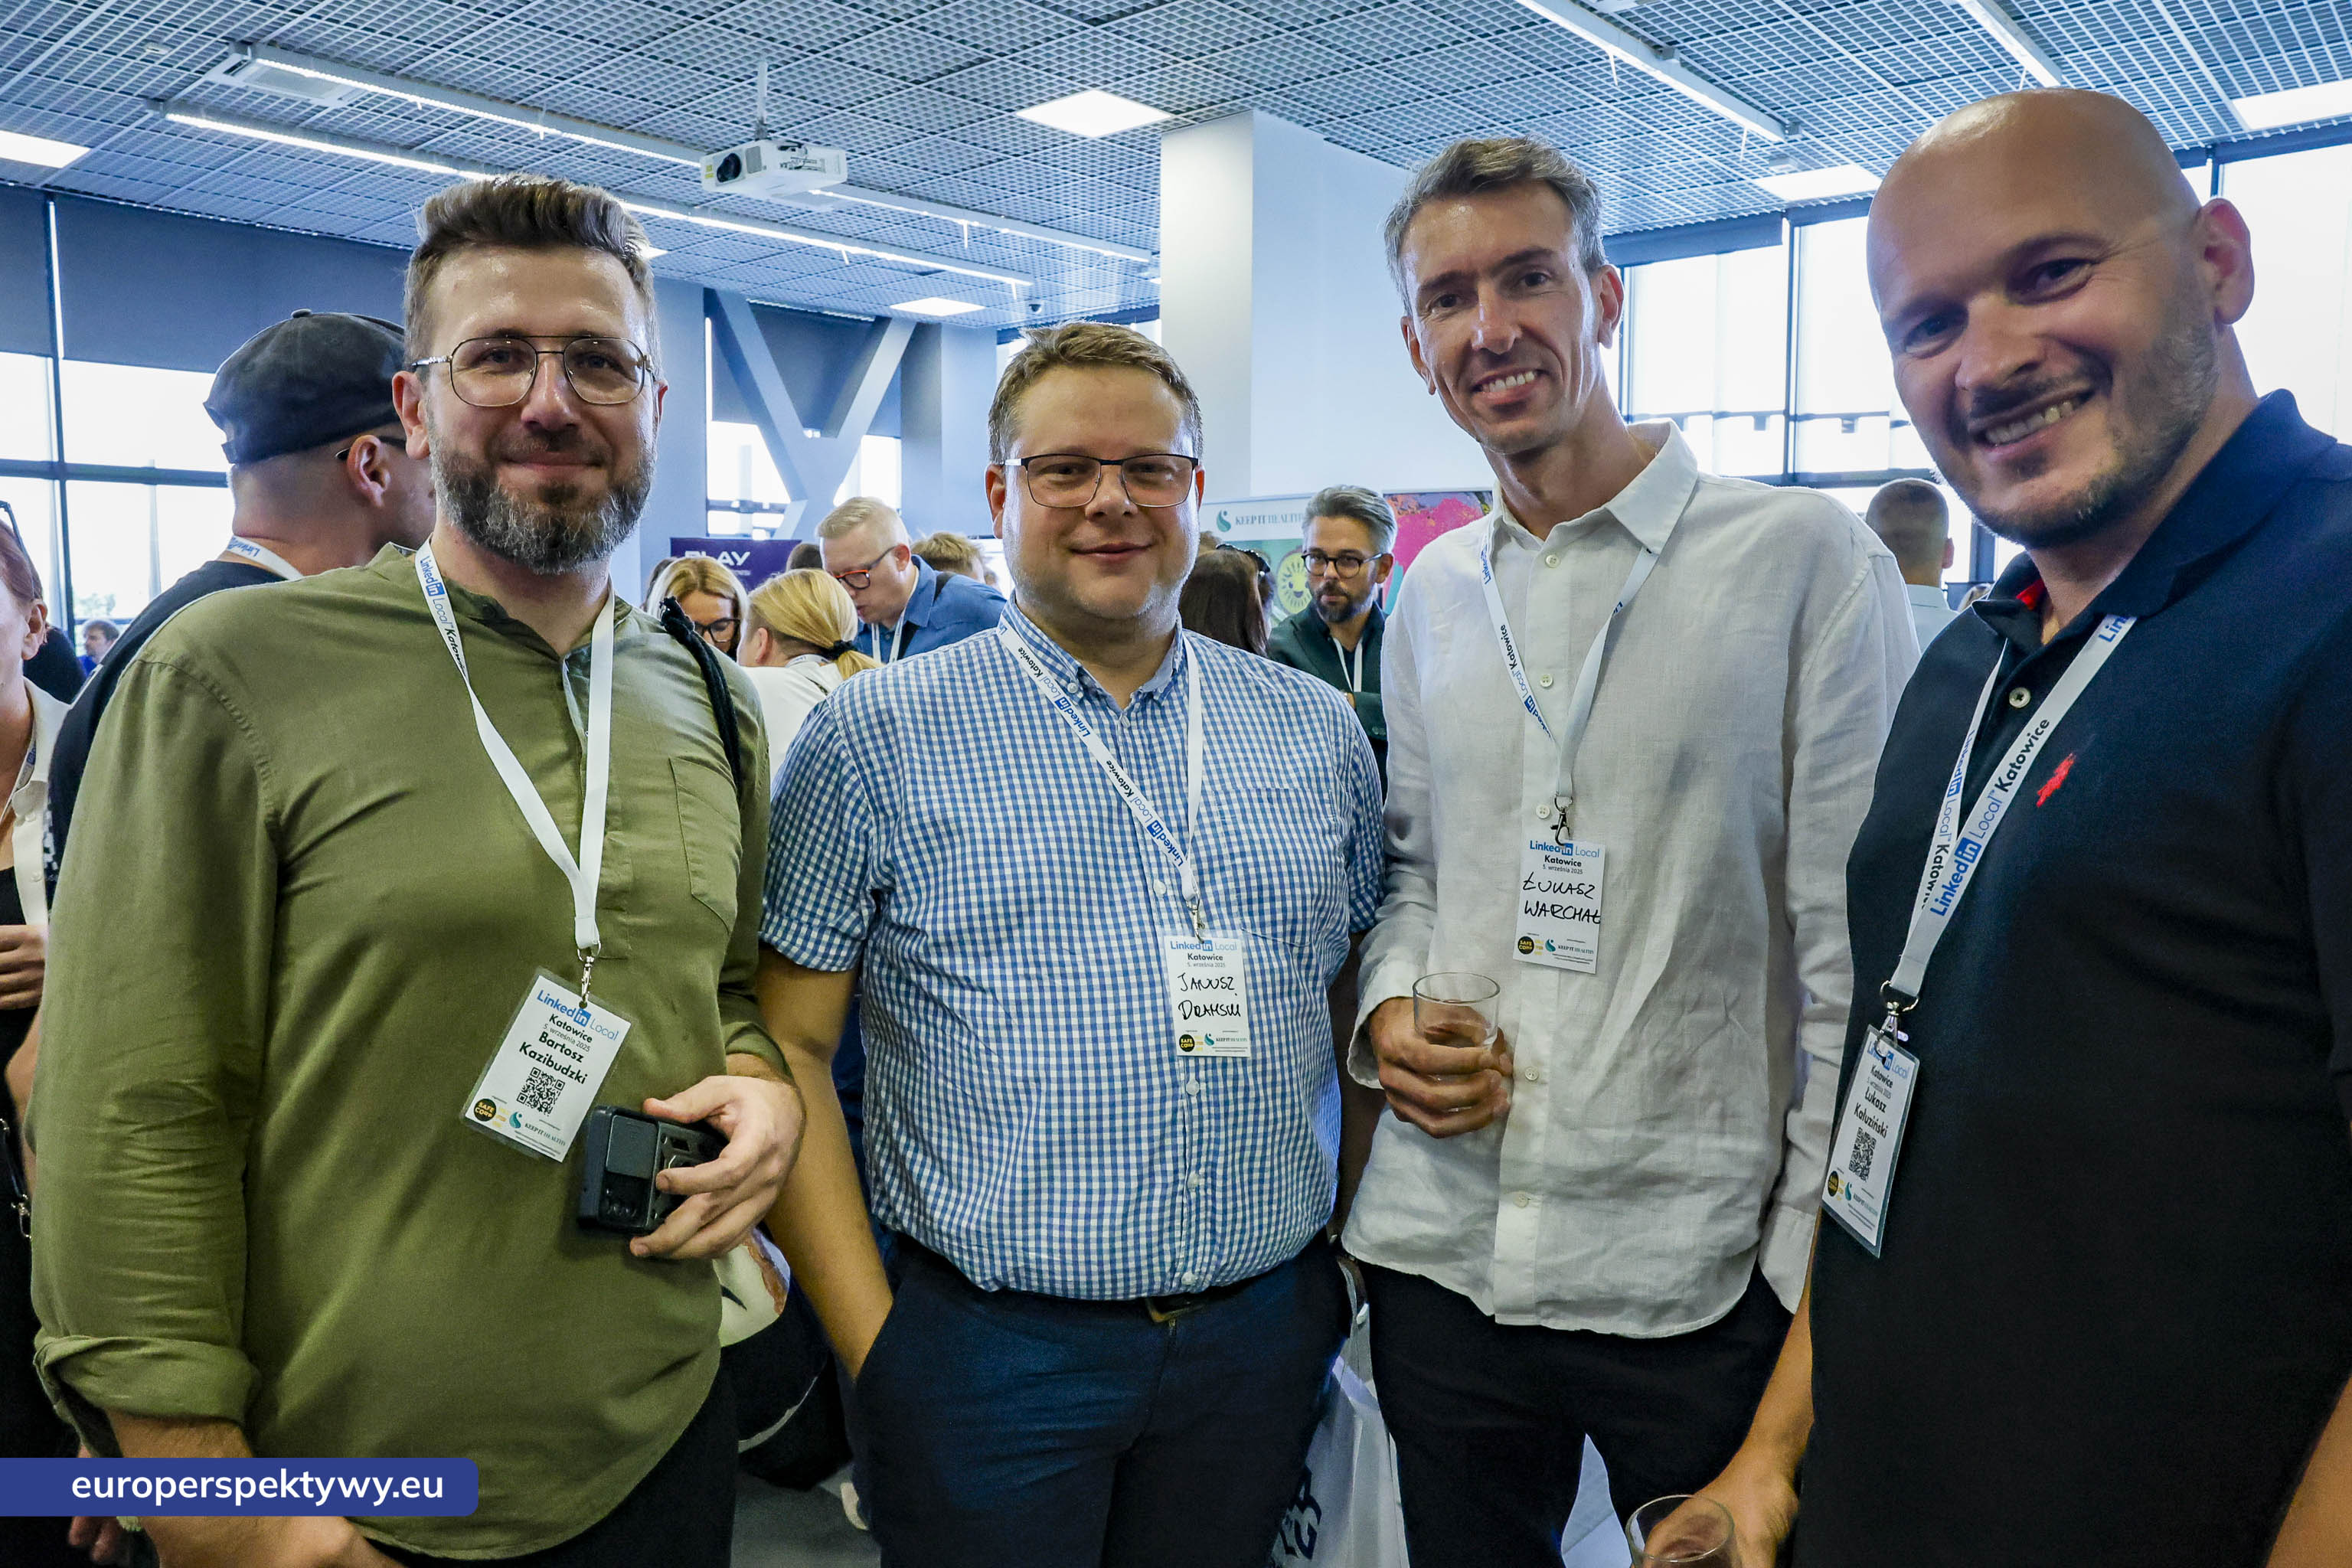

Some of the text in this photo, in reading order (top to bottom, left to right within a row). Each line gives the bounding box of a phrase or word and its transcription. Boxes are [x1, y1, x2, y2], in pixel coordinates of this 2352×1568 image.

[684, 550, 750, 566] AY
[420, 556, 446, 596] Linkedin
[1018, 647, 1044, 678] Katowice
[1501, 624, 1517, 670] Katowice
[1054, 696, 1092, 737] Linkedin
[1106, 760, 1135, 797] Katowice
[1929, 836, 1982, 916] Linkedin
[1994, 718, 2050, 792] Katowice
[1146, 819, 1184, 867] Linkedin
[1530, 840, 1599, 858] Linkedin Local
[1544, 854, 1582, 867] Katowice
[1170, 940, 1214, 952] Linkedin
[1187, 952, 1223, 961] Katowice
[537, 990, 619, 1040] Linkedin Local
[549, 1014, 593, 1043] Katowice
[538, 1031, 584, 1063] Bartosz
[576, 1040, 591, 1052] 2025
[519, 1042, 588, 1084] Kazibudzki
[1870, 1064, 1893, 1088] Katowice
